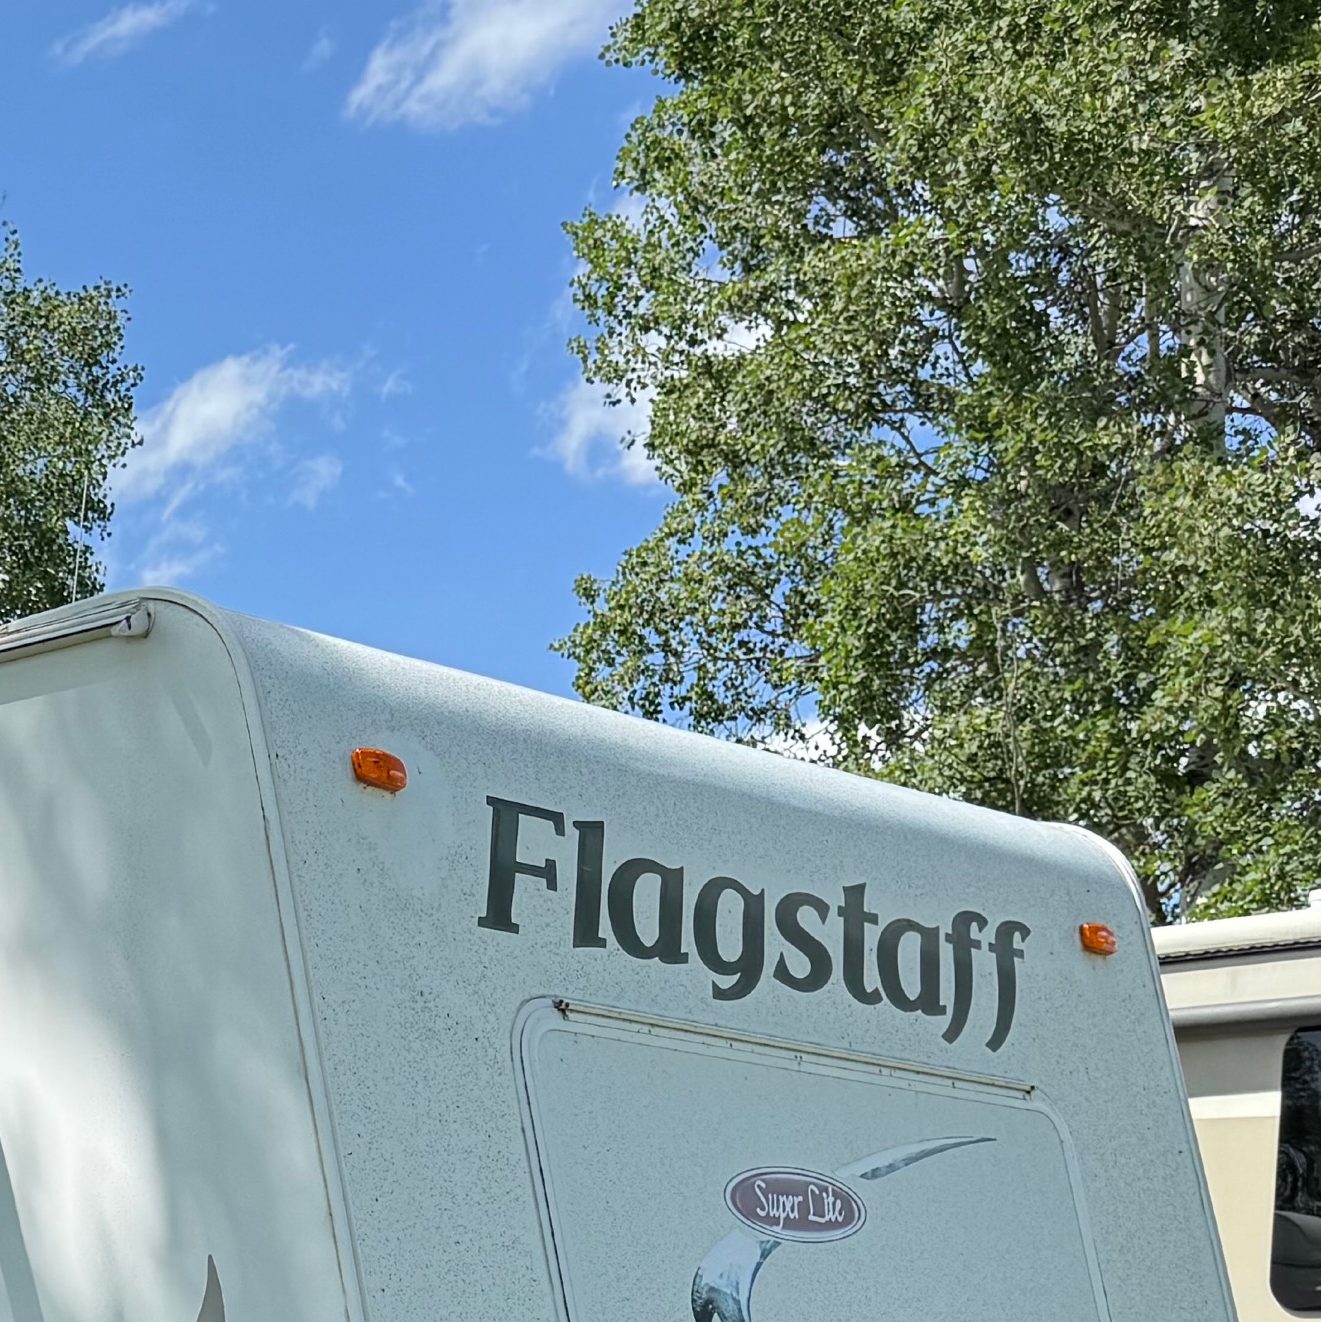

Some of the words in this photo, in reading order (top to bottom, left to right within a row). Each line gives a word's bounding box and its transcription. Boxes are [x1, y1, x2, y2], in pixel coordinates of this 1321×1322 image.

[477, 795, 1032, 1053] Flagstaff
[754, 1179, 803, 1231] Super
[807, 1184, 845, 1224] Lite
